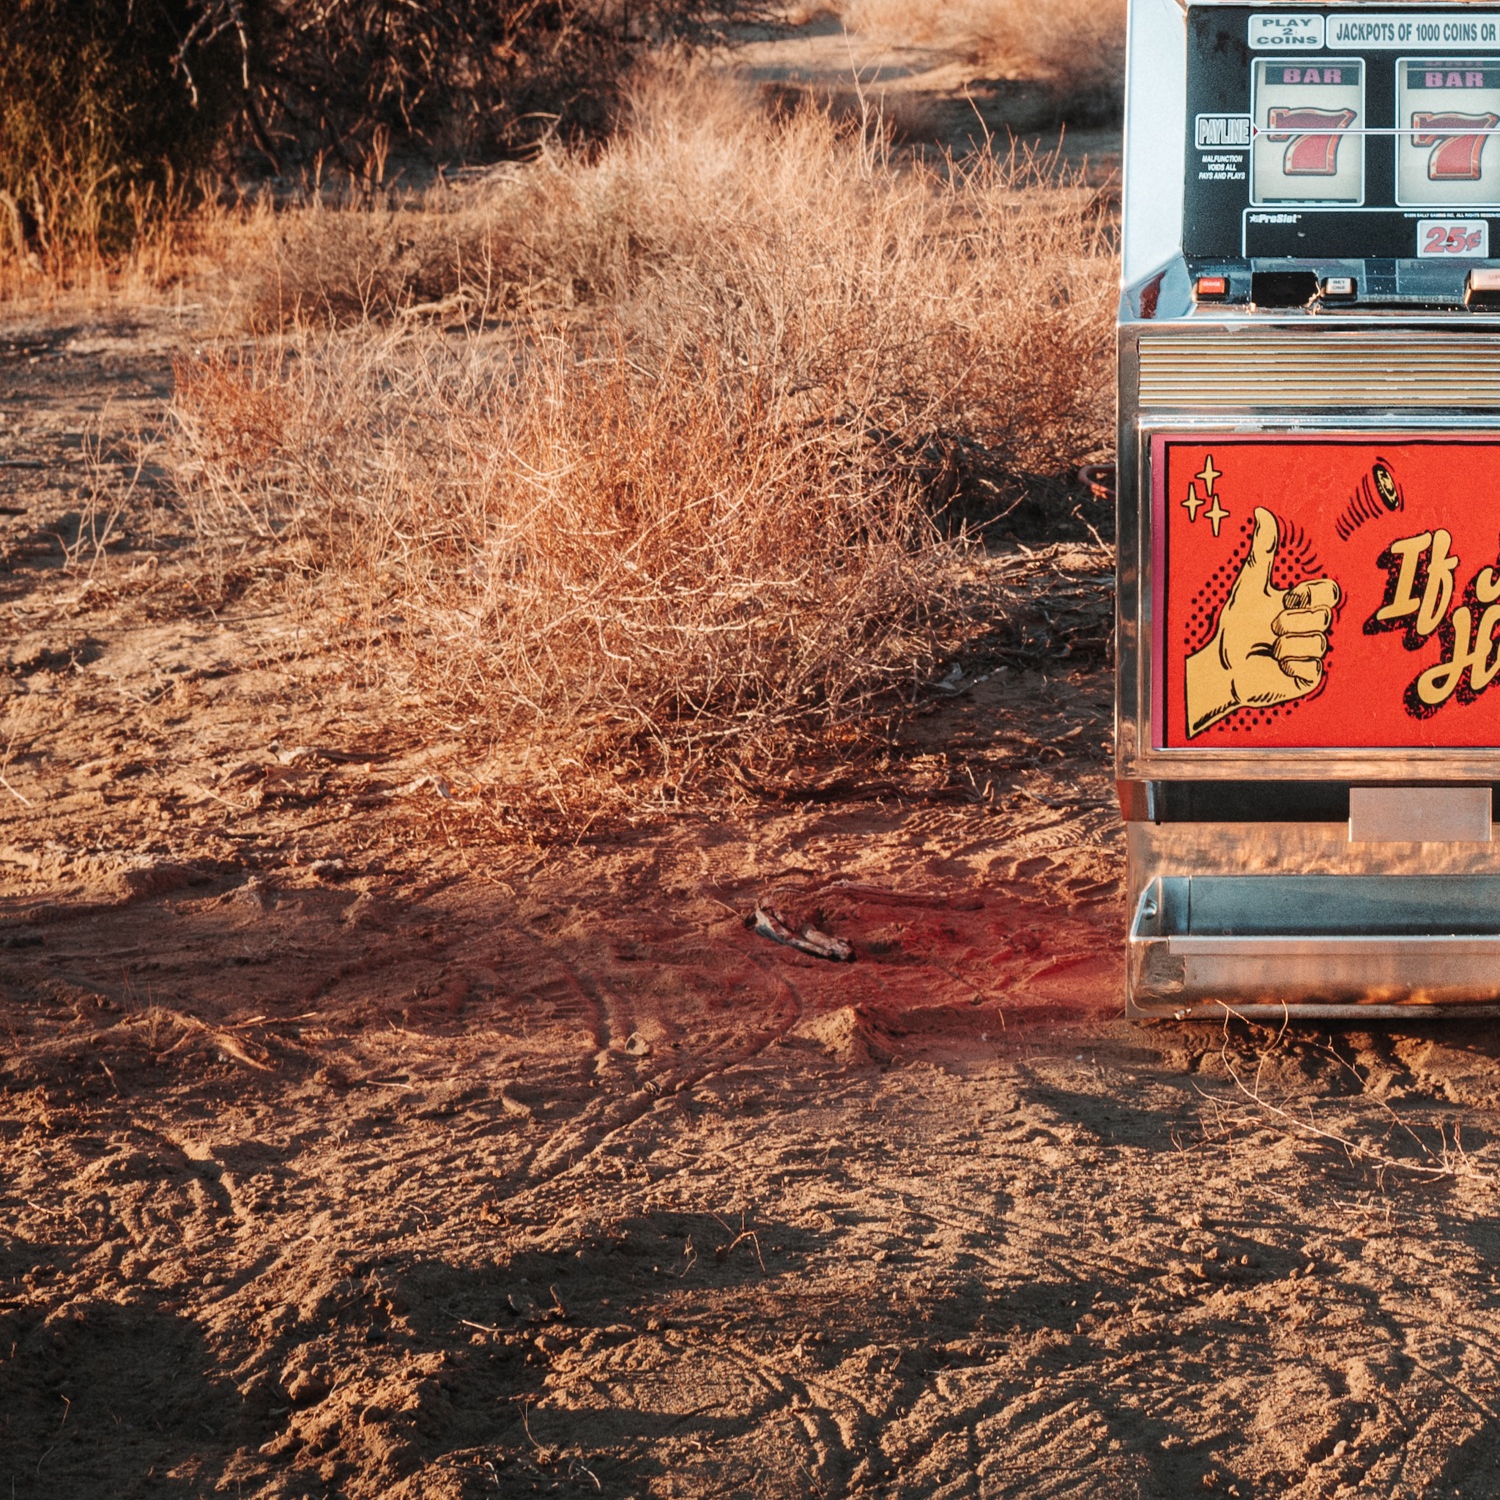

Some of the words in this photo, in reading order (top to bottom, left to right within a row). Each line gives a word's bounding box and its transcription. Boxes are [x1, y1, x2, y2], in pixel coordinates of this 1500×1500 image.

[1262, 18, 1313, 27] PLAY
[1256, 36, 1318, 45] COINS
[1282, 28, 1293, 36] 2
[1336, 22, 1395, 42] JACKPOTS
[1398, 22, 1412, 42] OF
[1416, 22, 1440, 42] 1000
[1443, 22, 1478, 42] COINS
[1480, 22, 1496, 42] OR
[1282, 67, 1342, 84] BAR
[1424, 71, 1484, 88] BAR
[1199, 118, 1250, 145] PAYLINE
[1267, 106, 1358, 177] 7
[1411, 111, 1500, 181] 7
[1201, 154, 1243, 163] MALFUNCTION
[1225, 163, 1237, 171] ALL
[1213, 171, 1227, 180] AND
[1227, 171, 1246, 180] PLAYS
[1370, 527, 1460, 642] If
